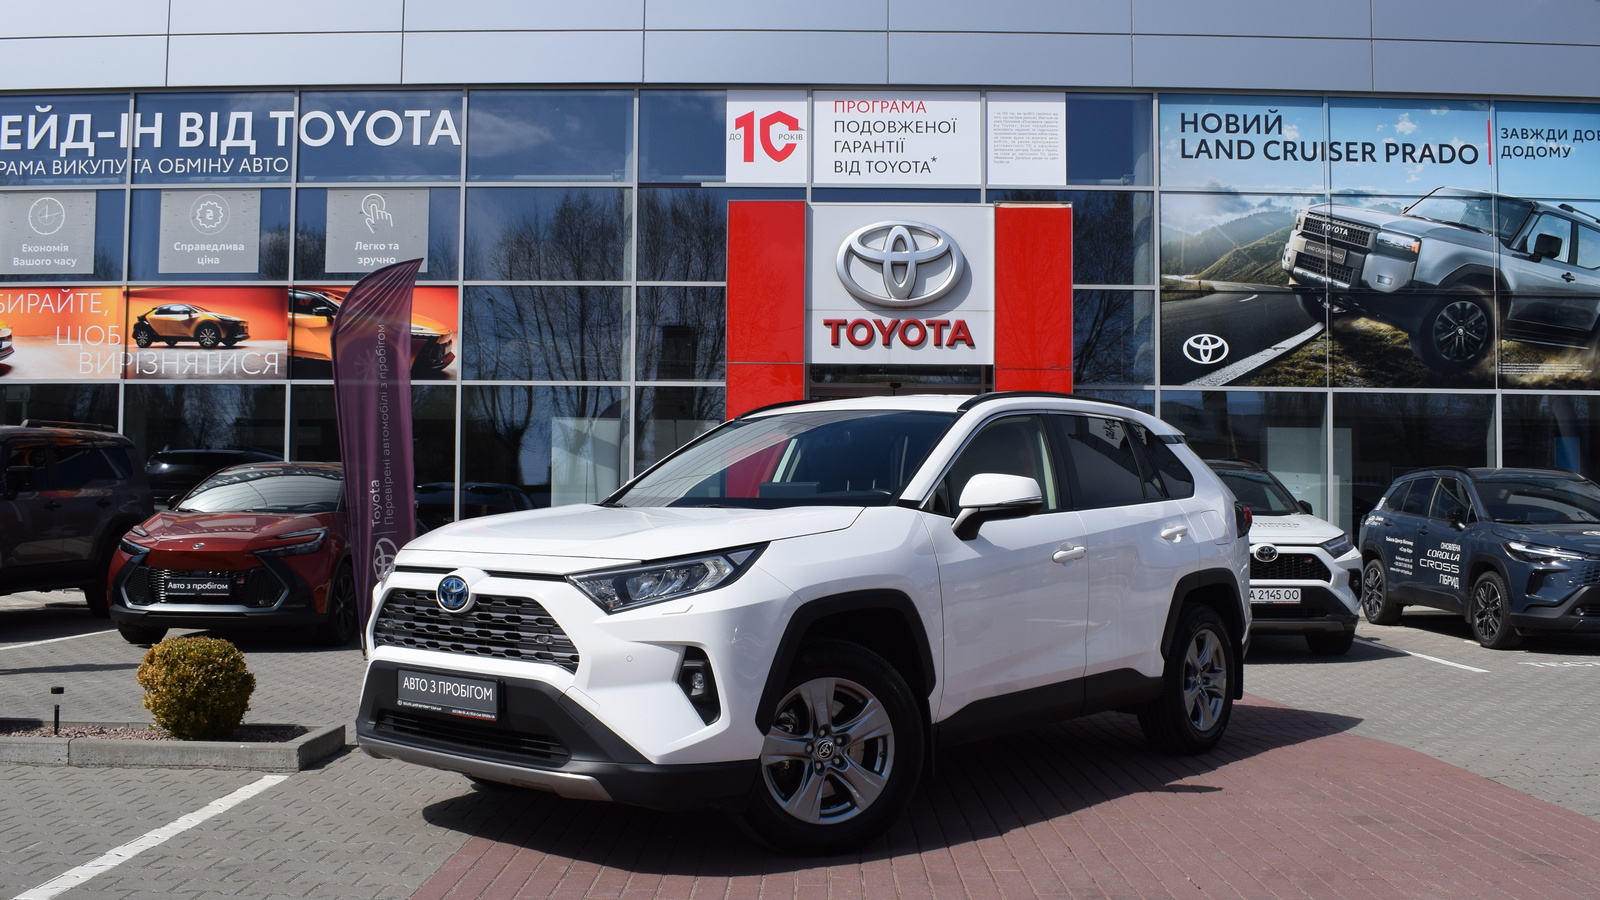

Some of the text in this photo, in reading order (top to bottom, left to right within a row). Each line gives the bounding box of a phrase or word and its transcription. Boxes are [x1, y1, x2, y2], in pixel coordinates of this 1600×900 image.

[834, 99, 927, 114] ПРОГРАМА
[834, 118, 958, 136] ПОДОВЖЕНОЇ
[1180, 109, 1283, 135] НОВИЙ
[179, 111, 256, 155] ВІД
[269, 110, 461, 147] TOYOTA
[729, 133, 742, 142] ДО
[778, 133, 803, 141] РОКІВ
[1500, 127, 1568, 143] ЗАВЖДИ
[834, 137, 906, 153] ГАРАНТІЇ
[1180, 138, 1479, 165] LAND CRUISER PRADO
[1501, 145, 1572, 160] ДОДОМУ
[52, 159, 127, 175] ВИКУПУ
[133, 158, 153, 174] ТА
[158, 157, 234, 174] ОБМІНУ
[238, 157, 289, 173] АВТО
[834, 160, 861, 176] ВІД
[21, 243, 69, 253] Економія
[173, 242, 245, 252] Справедлива
[355, 241, 400, 252] Легко та
[12, 257, 77, 267] Вашого часу
[197, 254, 220, 265] ціна
[357, 256, 397, 266] зручно
[56, 325, 121, 346] ЩОБ
[822, 318, 977, 348] TOYOTA
[375, 324, 389, 379] пробігом
[79, 350, 280, 375] ВИРІЗНЯТИСЯ
[379, 391, 391, 456] автомобілі
[382, 459, 395, 525] Перевірені
[369, 479, 382, 528] Toyota
[1427, 549, 1460, 561] COROLLA
[1420, 558, 1460, 573] CROSS
[193, 582, 228, 590] пробігом
[1258, 589, 1282, 600] 2145
[403, 677, 493, 701] АВТО З ПРОБІГОМ
